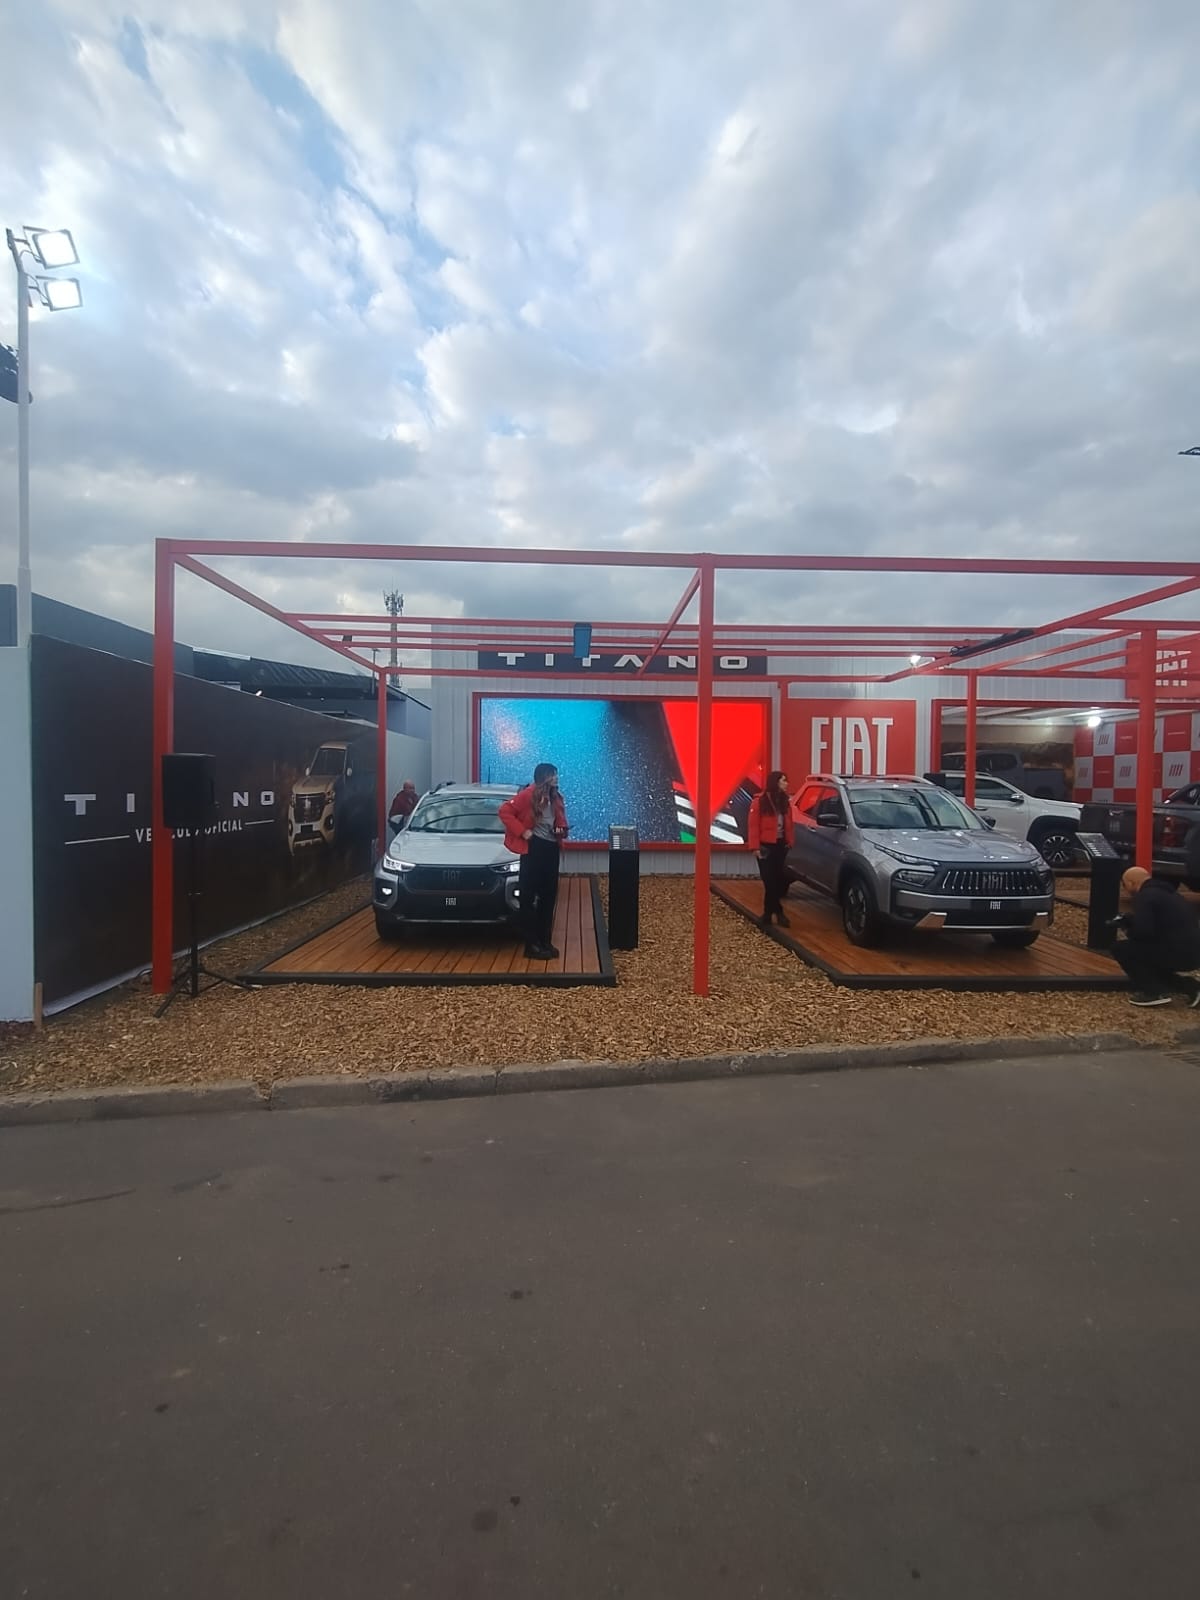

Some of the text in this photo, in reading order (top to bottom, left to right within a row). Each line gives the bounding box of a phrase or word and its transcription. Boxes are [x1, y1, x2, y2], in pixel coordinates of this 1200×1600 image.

[497, 652, 748, 670] TITANO
[1155, 650, 1192, 687] IAT
[811, 717, 894, 776] FIAT
[64, 791, 275, 815] TINO
[982, 871, 1005, 890] FIAT
